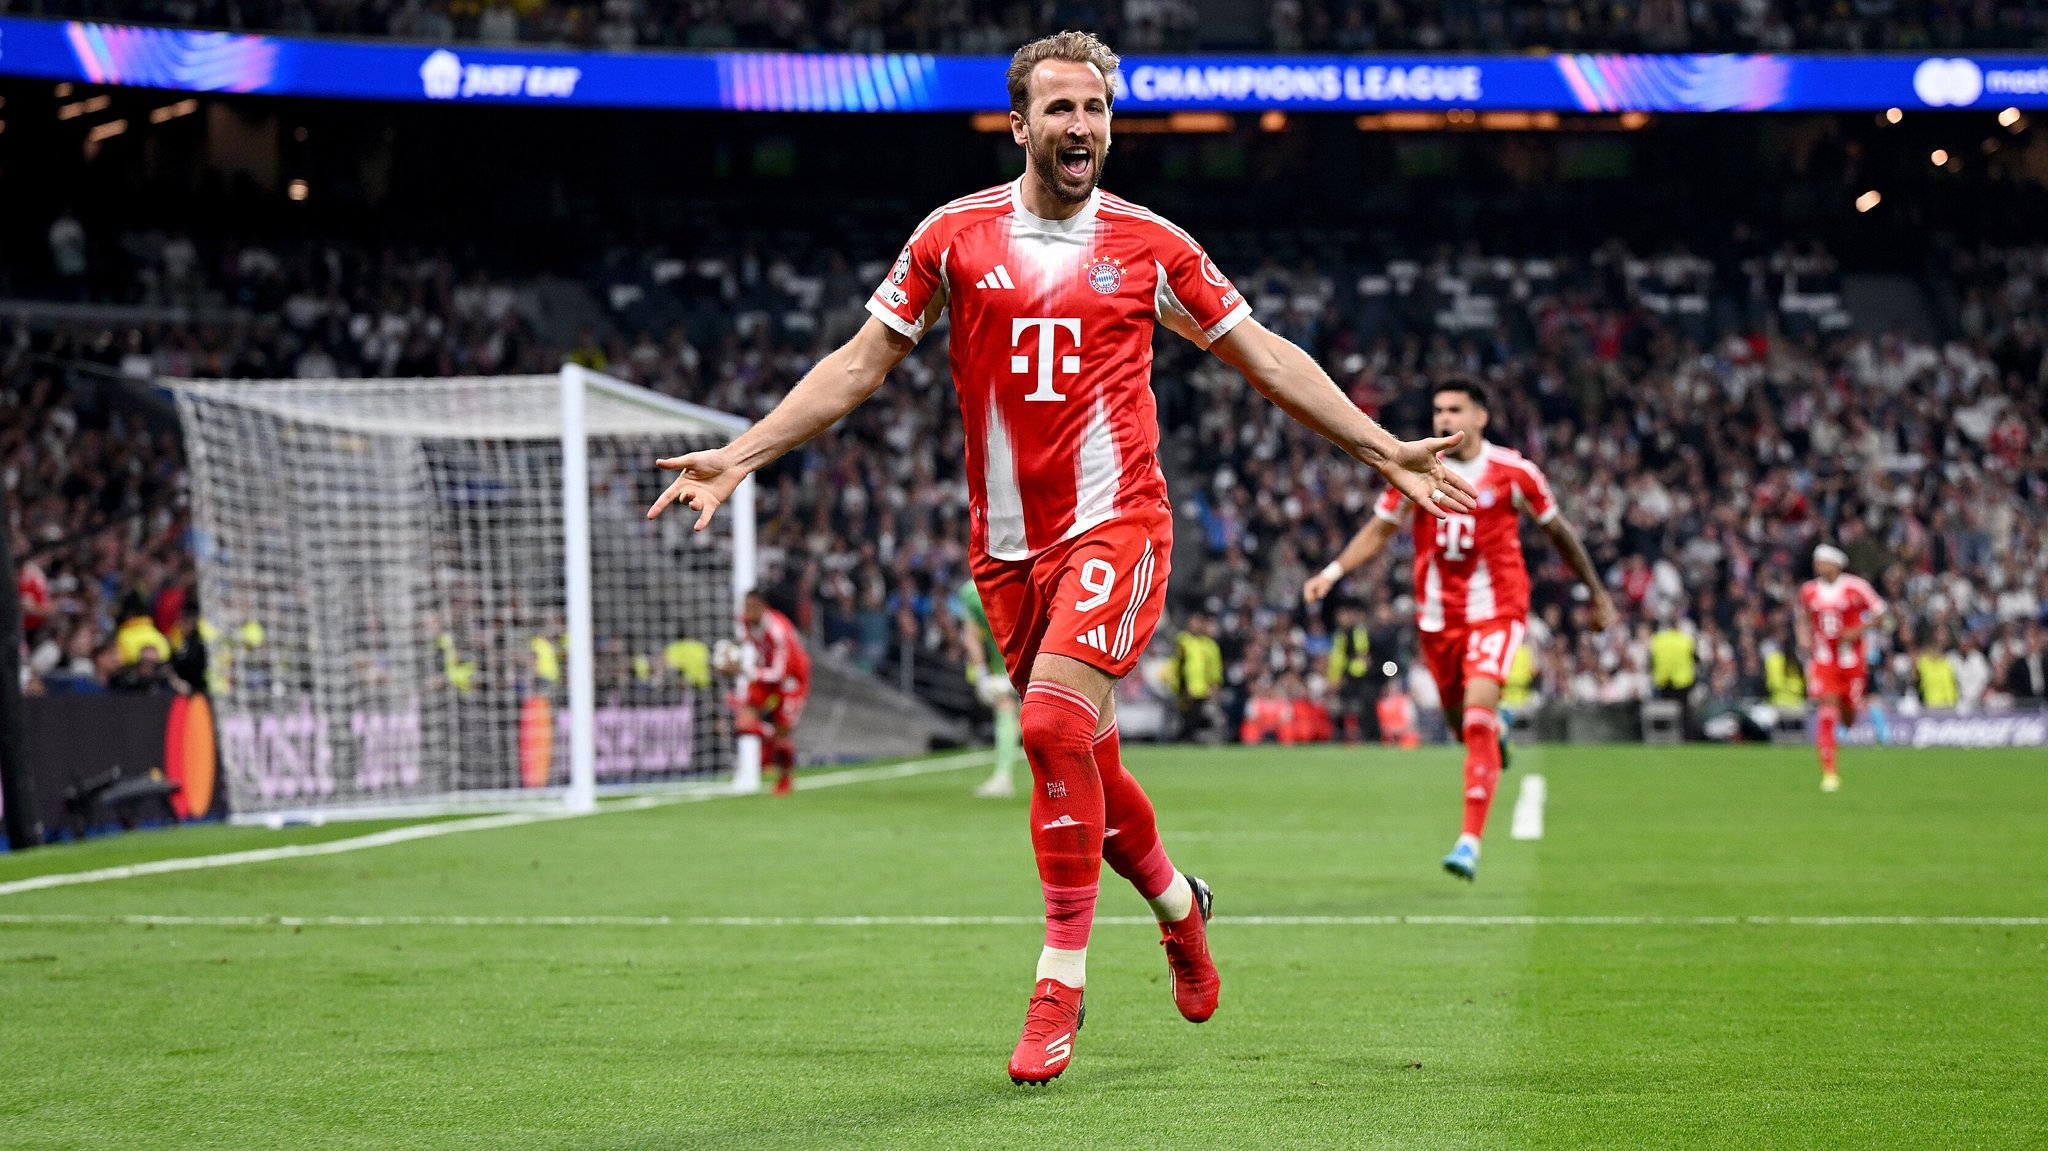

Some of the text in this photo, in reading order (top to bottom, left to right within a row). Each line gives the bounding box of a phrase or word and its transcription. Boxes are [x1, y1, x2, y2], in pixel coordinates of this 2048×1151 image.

[526, 66, 582, 98] EAT
[1131, 65, 1342, 101] CHAMPIONS
[1344, 65, 1483, 101] LEAGUE
[1011, 317, 1082, 402] T
[1075, 558, 1116, 612] 9
